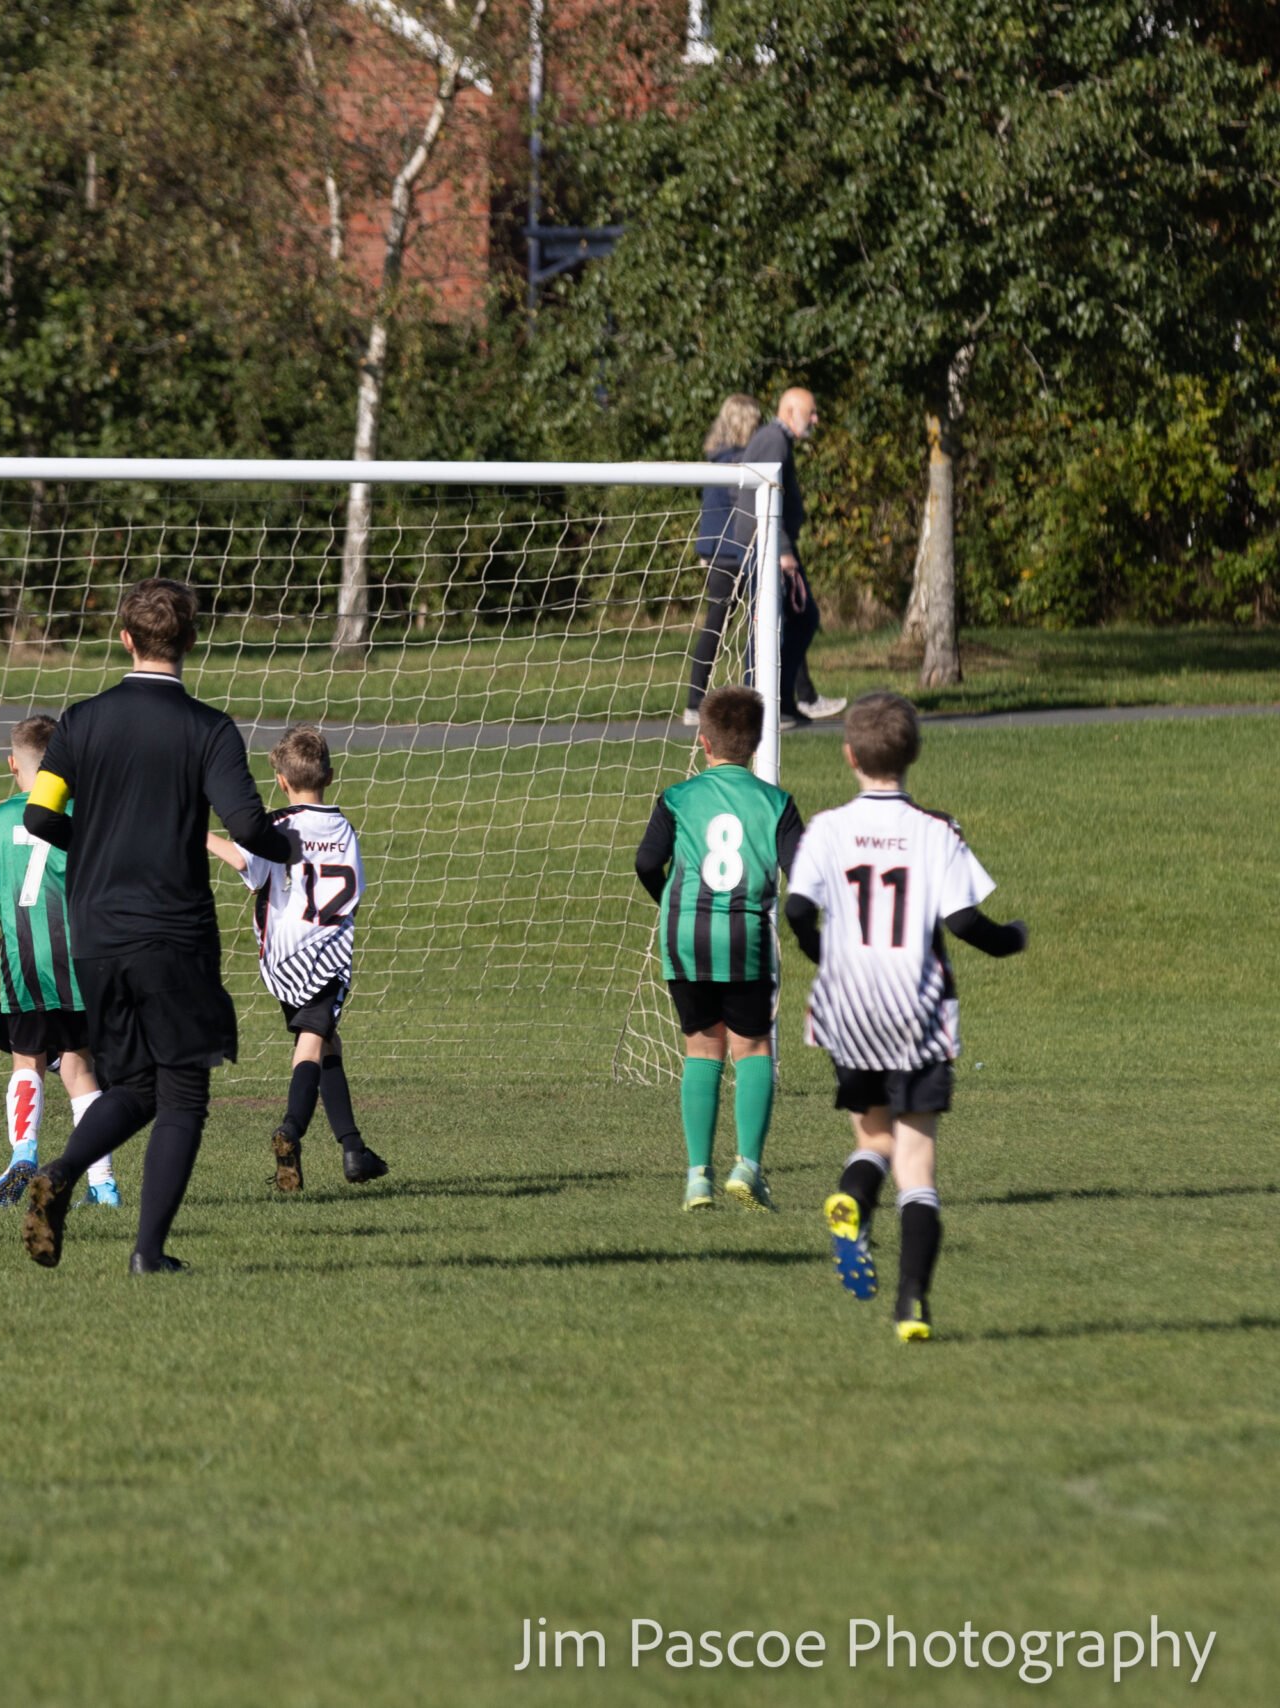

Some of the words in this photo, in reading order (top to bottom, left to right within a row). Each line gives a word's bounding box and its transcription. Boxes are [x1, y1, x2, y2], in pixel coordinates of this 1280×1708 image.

[13, 825, 52, 907] 7
[304, 841, 345, 852] WWFC
[702, 813, 743, 892] 8
[855, 836, 907, 850] WWFC
[301, 863, 356, 927] 12
[845, 864, 908, 948] 11
